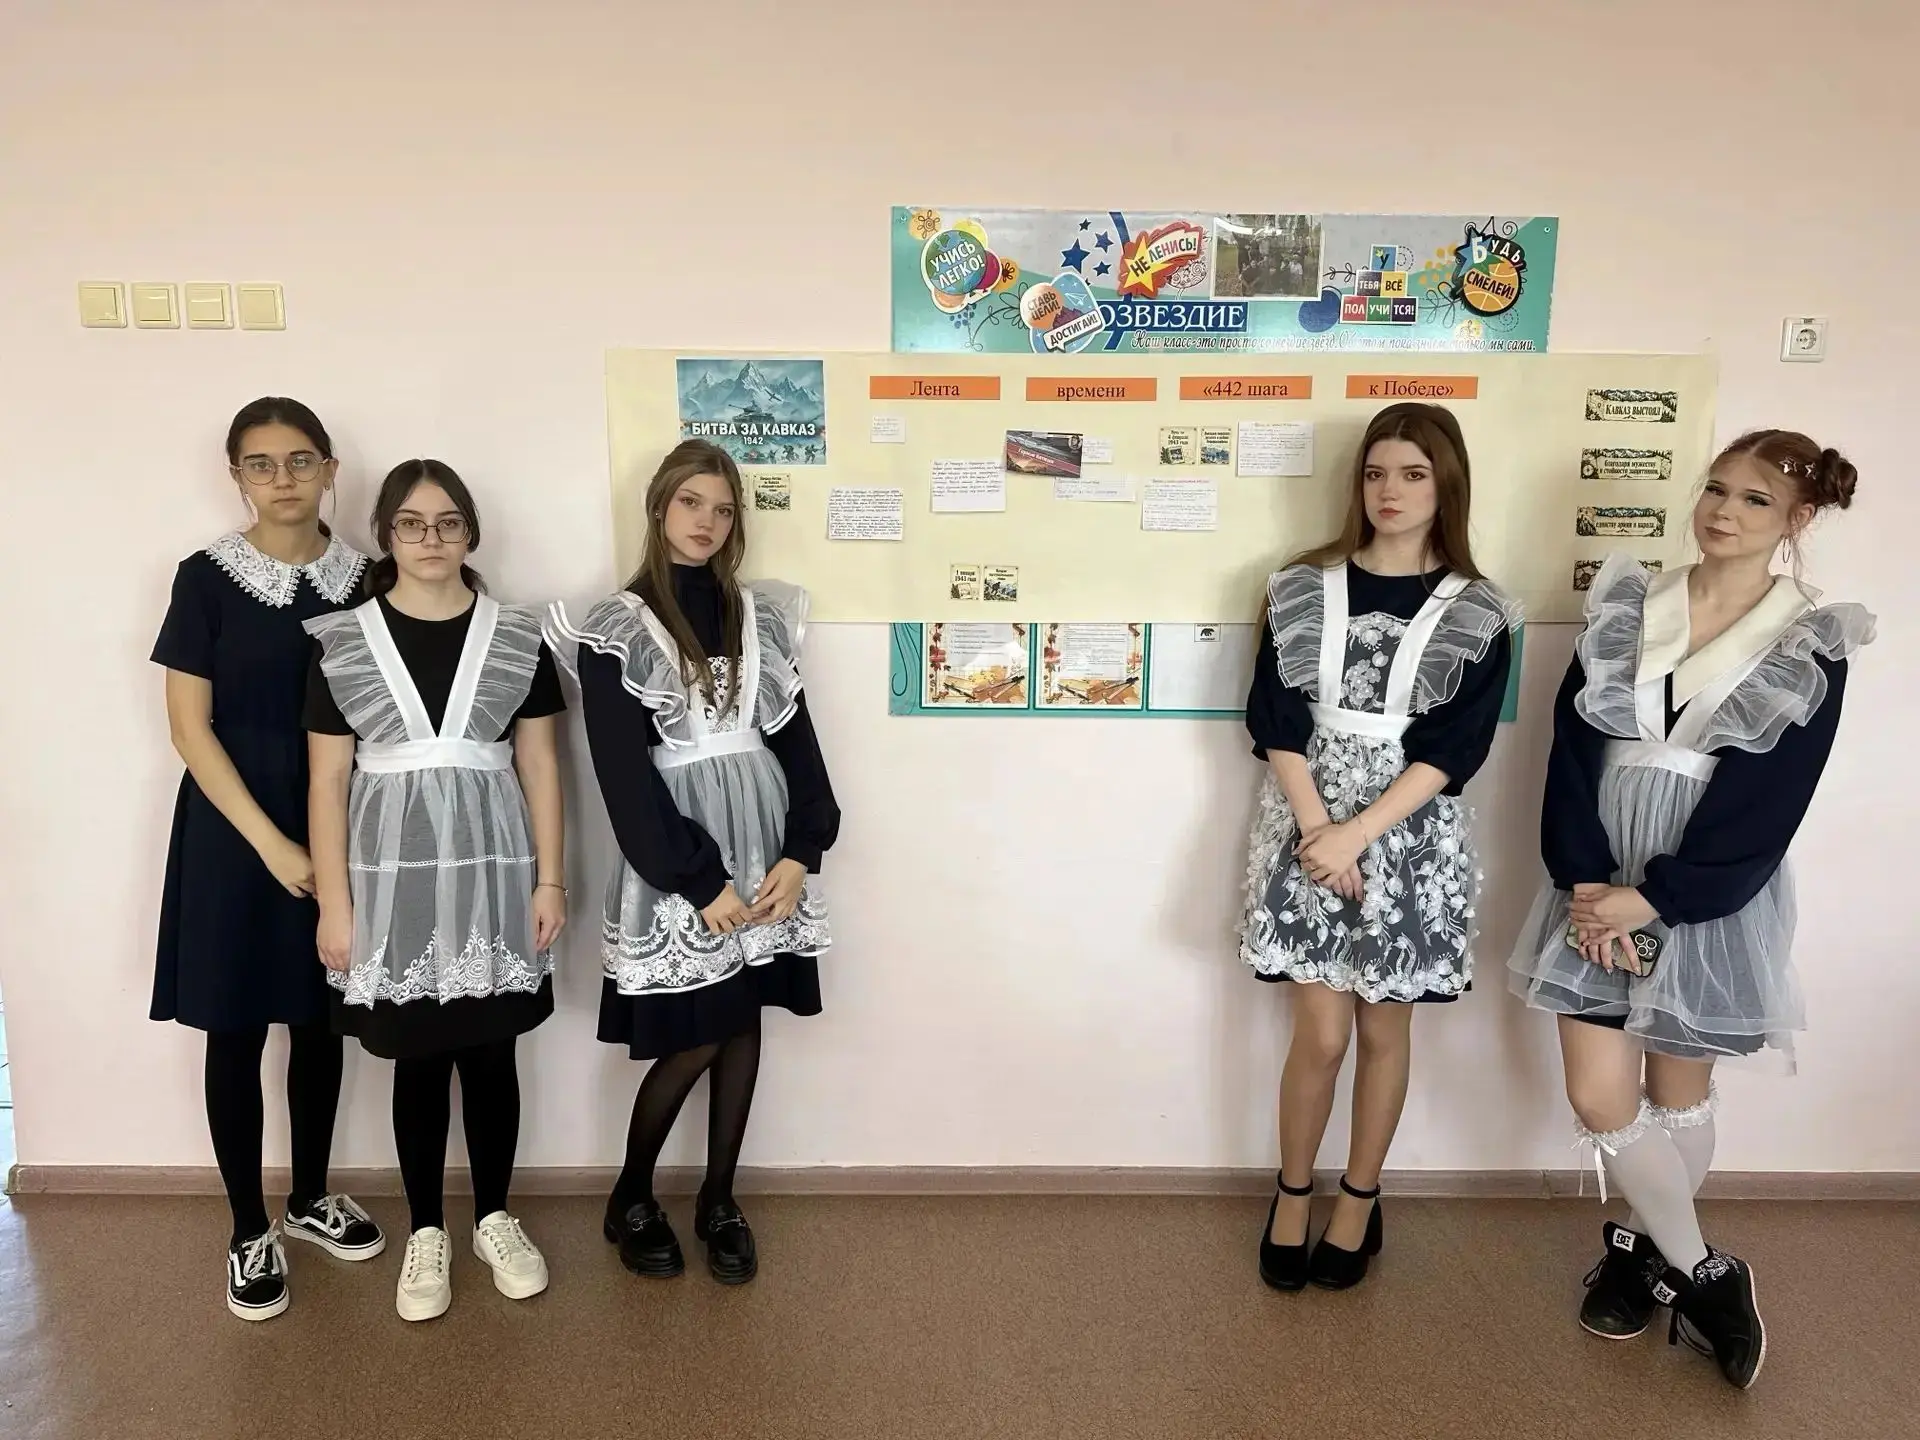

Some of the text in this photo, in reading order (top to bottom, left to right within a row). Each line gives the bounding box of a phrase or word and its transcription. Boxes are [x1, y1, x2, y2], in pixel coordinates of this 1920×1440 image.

[930, 241, 976, 272] УЧИСЬ
[1129, 237, 1197, 277] НЕ ЛЕНИСЬ!
[939, 254, 985, 289] ЛЕГКО!
[1359, 278, 1402, 291] ТЕБЯ ВСЁ
[1466, 271, 1515, 300] СМЕЛЕЙ!
[1028, 291, 1057, 311] СТАВЬ
[1031, 300, 1060, 321] ЦЕЛИ!
[1097, 304, 1245, 332] ОЗВЕЗДИЕ
[1049, 312, 1098, 347] ДОСТИГАЙ!
[1131, 329, 1161, 349] Наш
[1219, 337, 1258, 351] просто
[1488, 340, 1504, 351] мы
[1507, 340, 1536, 351] сами.
[910, 380, 1454, 401] Лента времени «442 шага к Победе»
[691, 422, 816, 436] БИТВА ЗА КАВКАЗ
[743, 436, 764, 445] 1942
